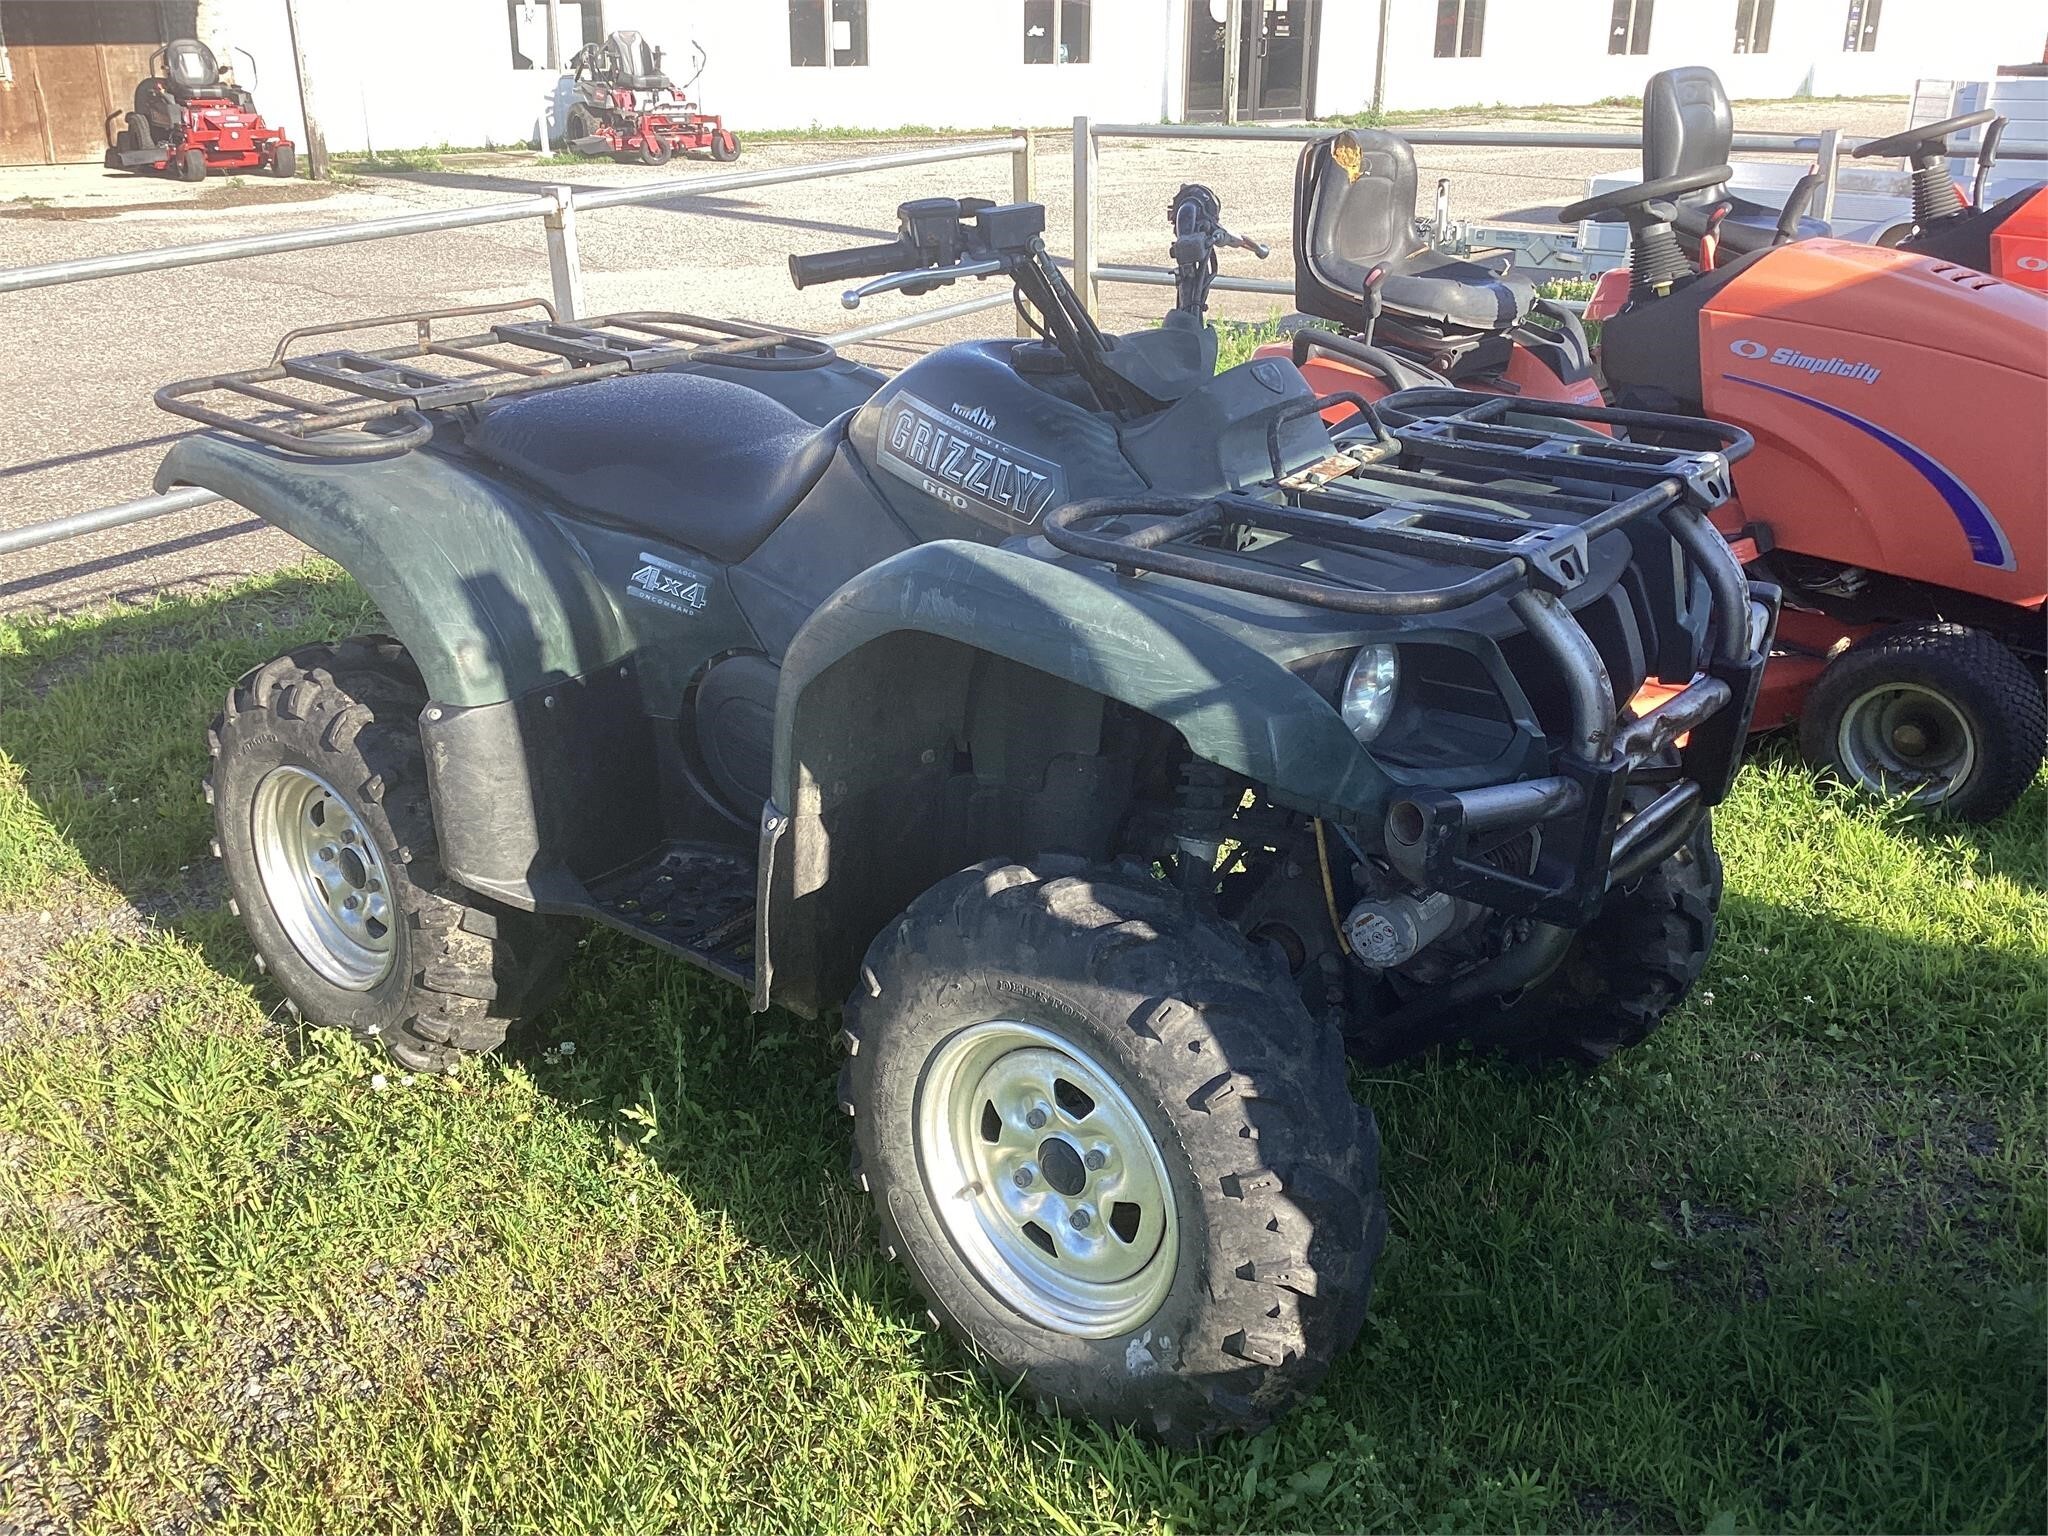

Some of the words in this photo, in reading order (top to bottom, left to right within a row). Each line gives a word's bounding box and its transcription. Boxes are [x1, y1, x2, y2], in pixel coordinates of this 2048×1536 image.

[1770, 347, 1883, 385] Simplicity
[890, 408, 1048, 514] GRIZZLY
[922, 479, 969, 509] 660
